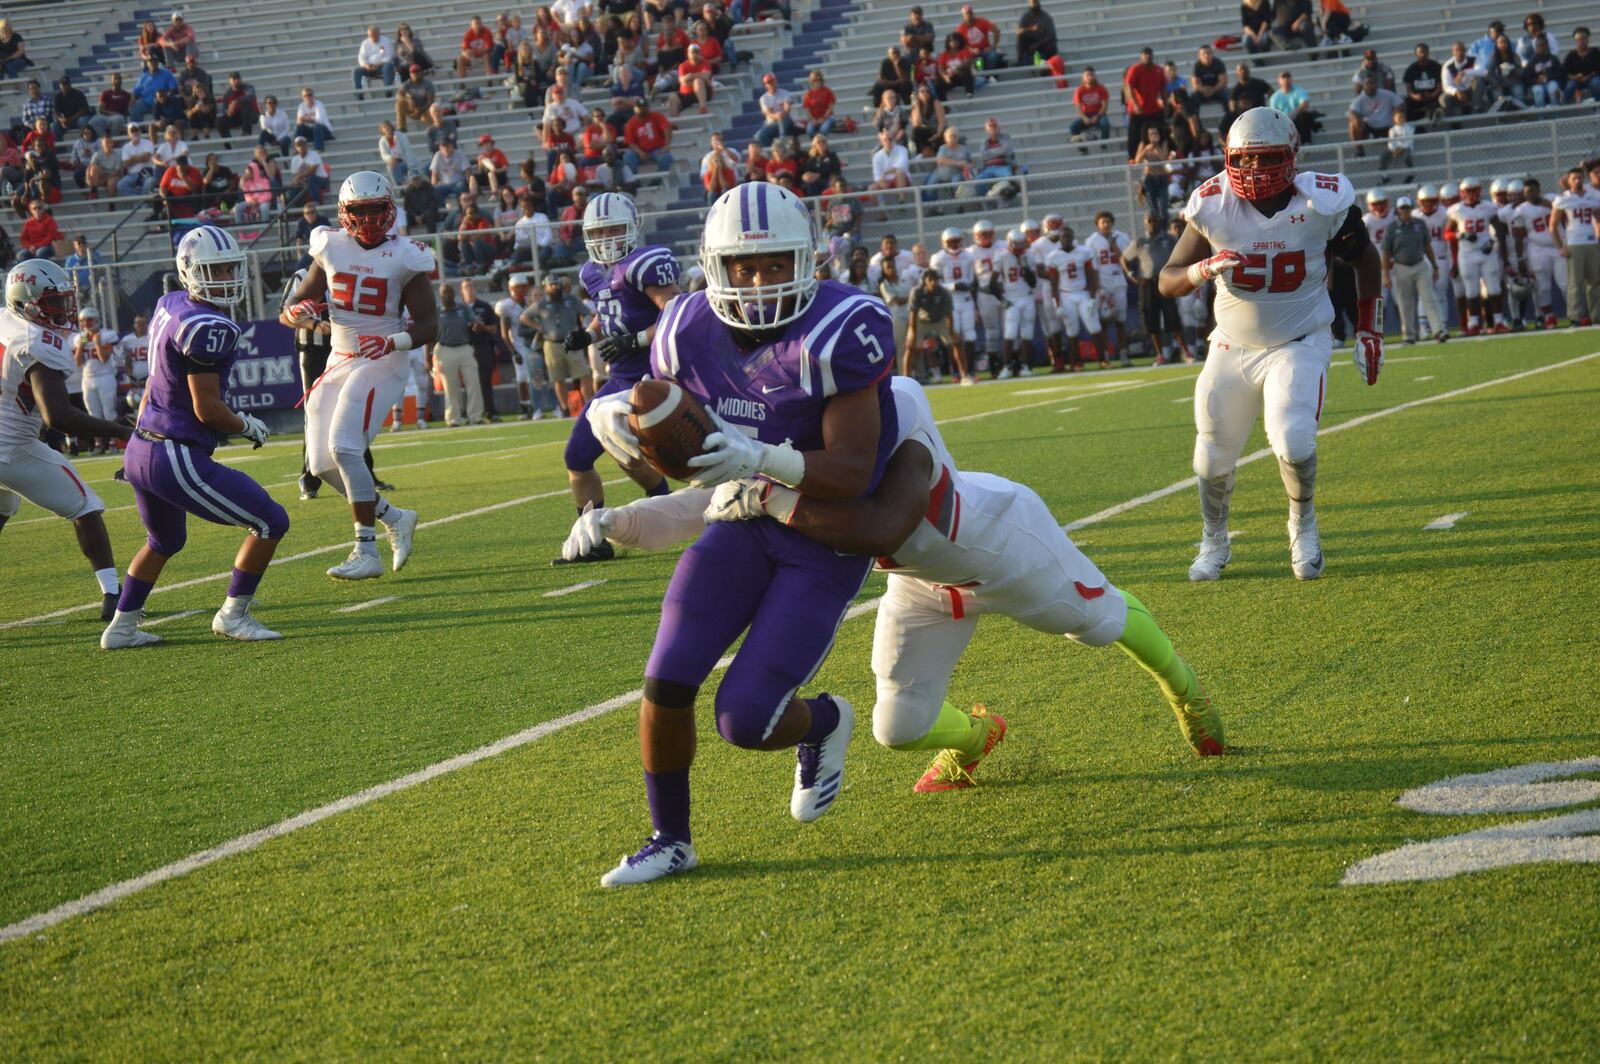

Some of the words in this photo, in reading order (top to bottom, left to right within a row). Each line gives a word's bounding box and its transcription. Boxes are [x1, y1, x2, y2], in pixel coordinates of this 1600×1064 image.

[743, 232, 768, 240] Riddell
[1252, 241, 1286, 250] SPARTANS
[656, 262, 675, 286] 53
[332, 272, 388, 316] 33
[206, 328, 228, 353] 57
[854, 322, 884, 364] 5
[716, 396, 766, 421] MIDDIES
